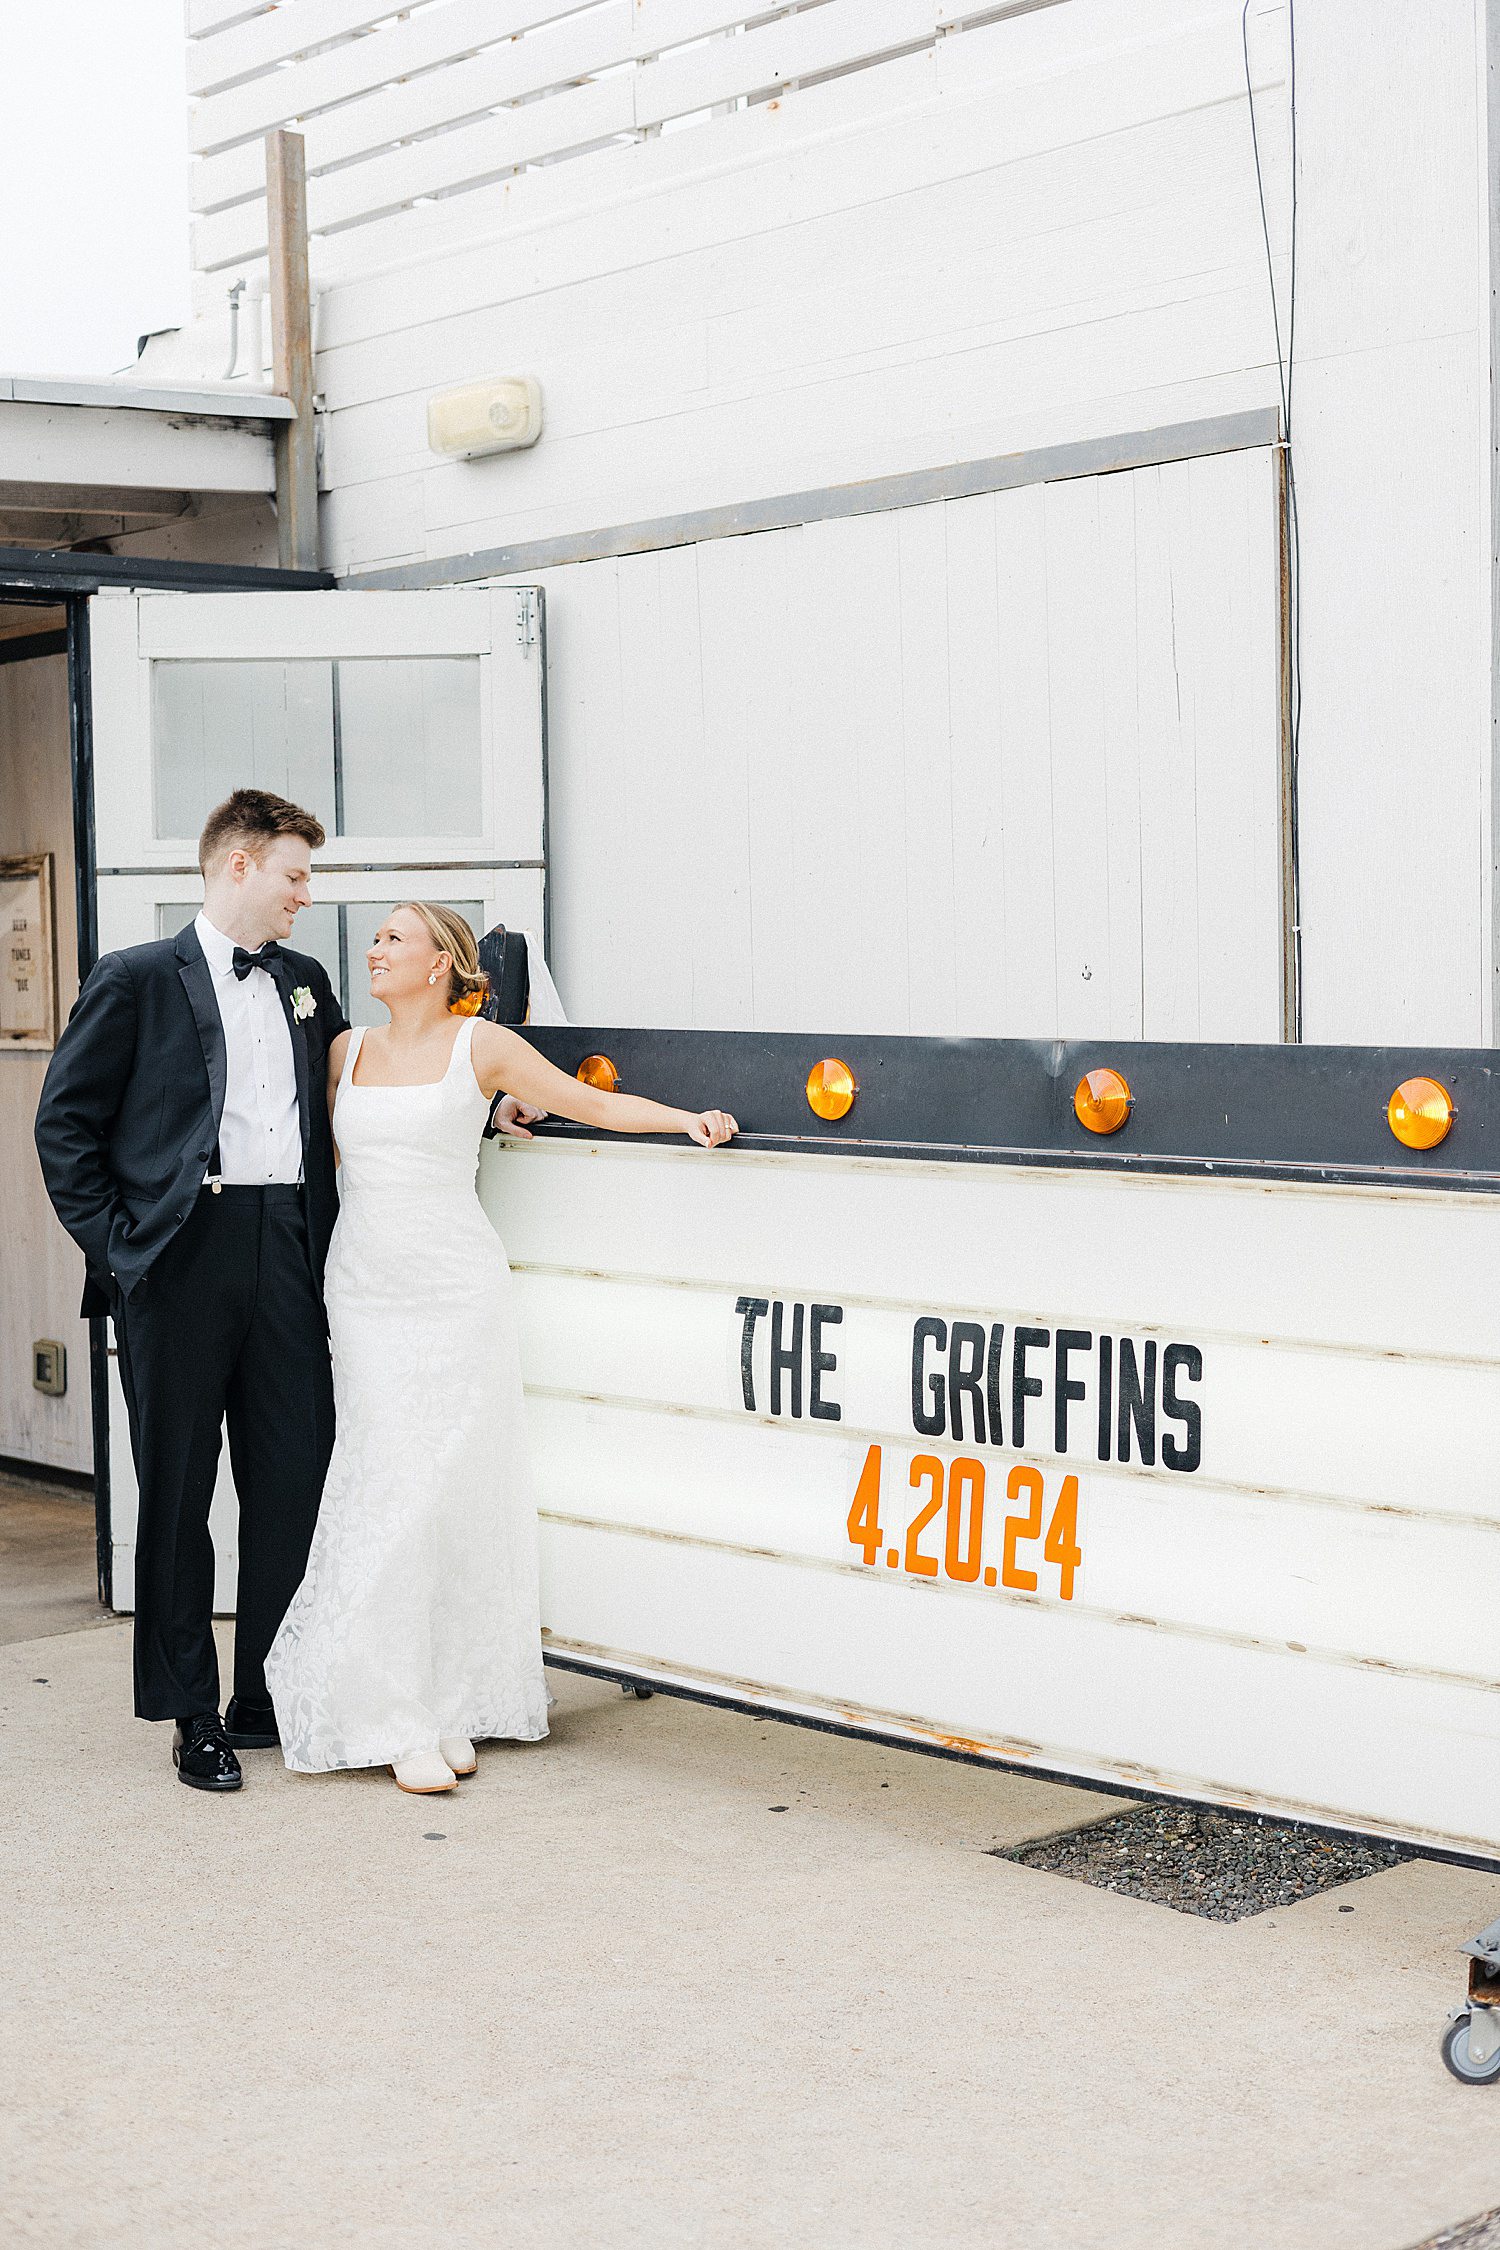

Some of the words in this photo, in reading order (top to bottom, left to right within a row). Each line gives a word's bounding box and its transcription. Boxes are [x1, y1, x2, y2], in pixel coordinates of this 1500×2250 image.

[735, 1296, 843, 1421] THE
[912, 1317, 1202, 1472] GRIFFINS
[847, 1445, 1082, 1600] 4.20.24
